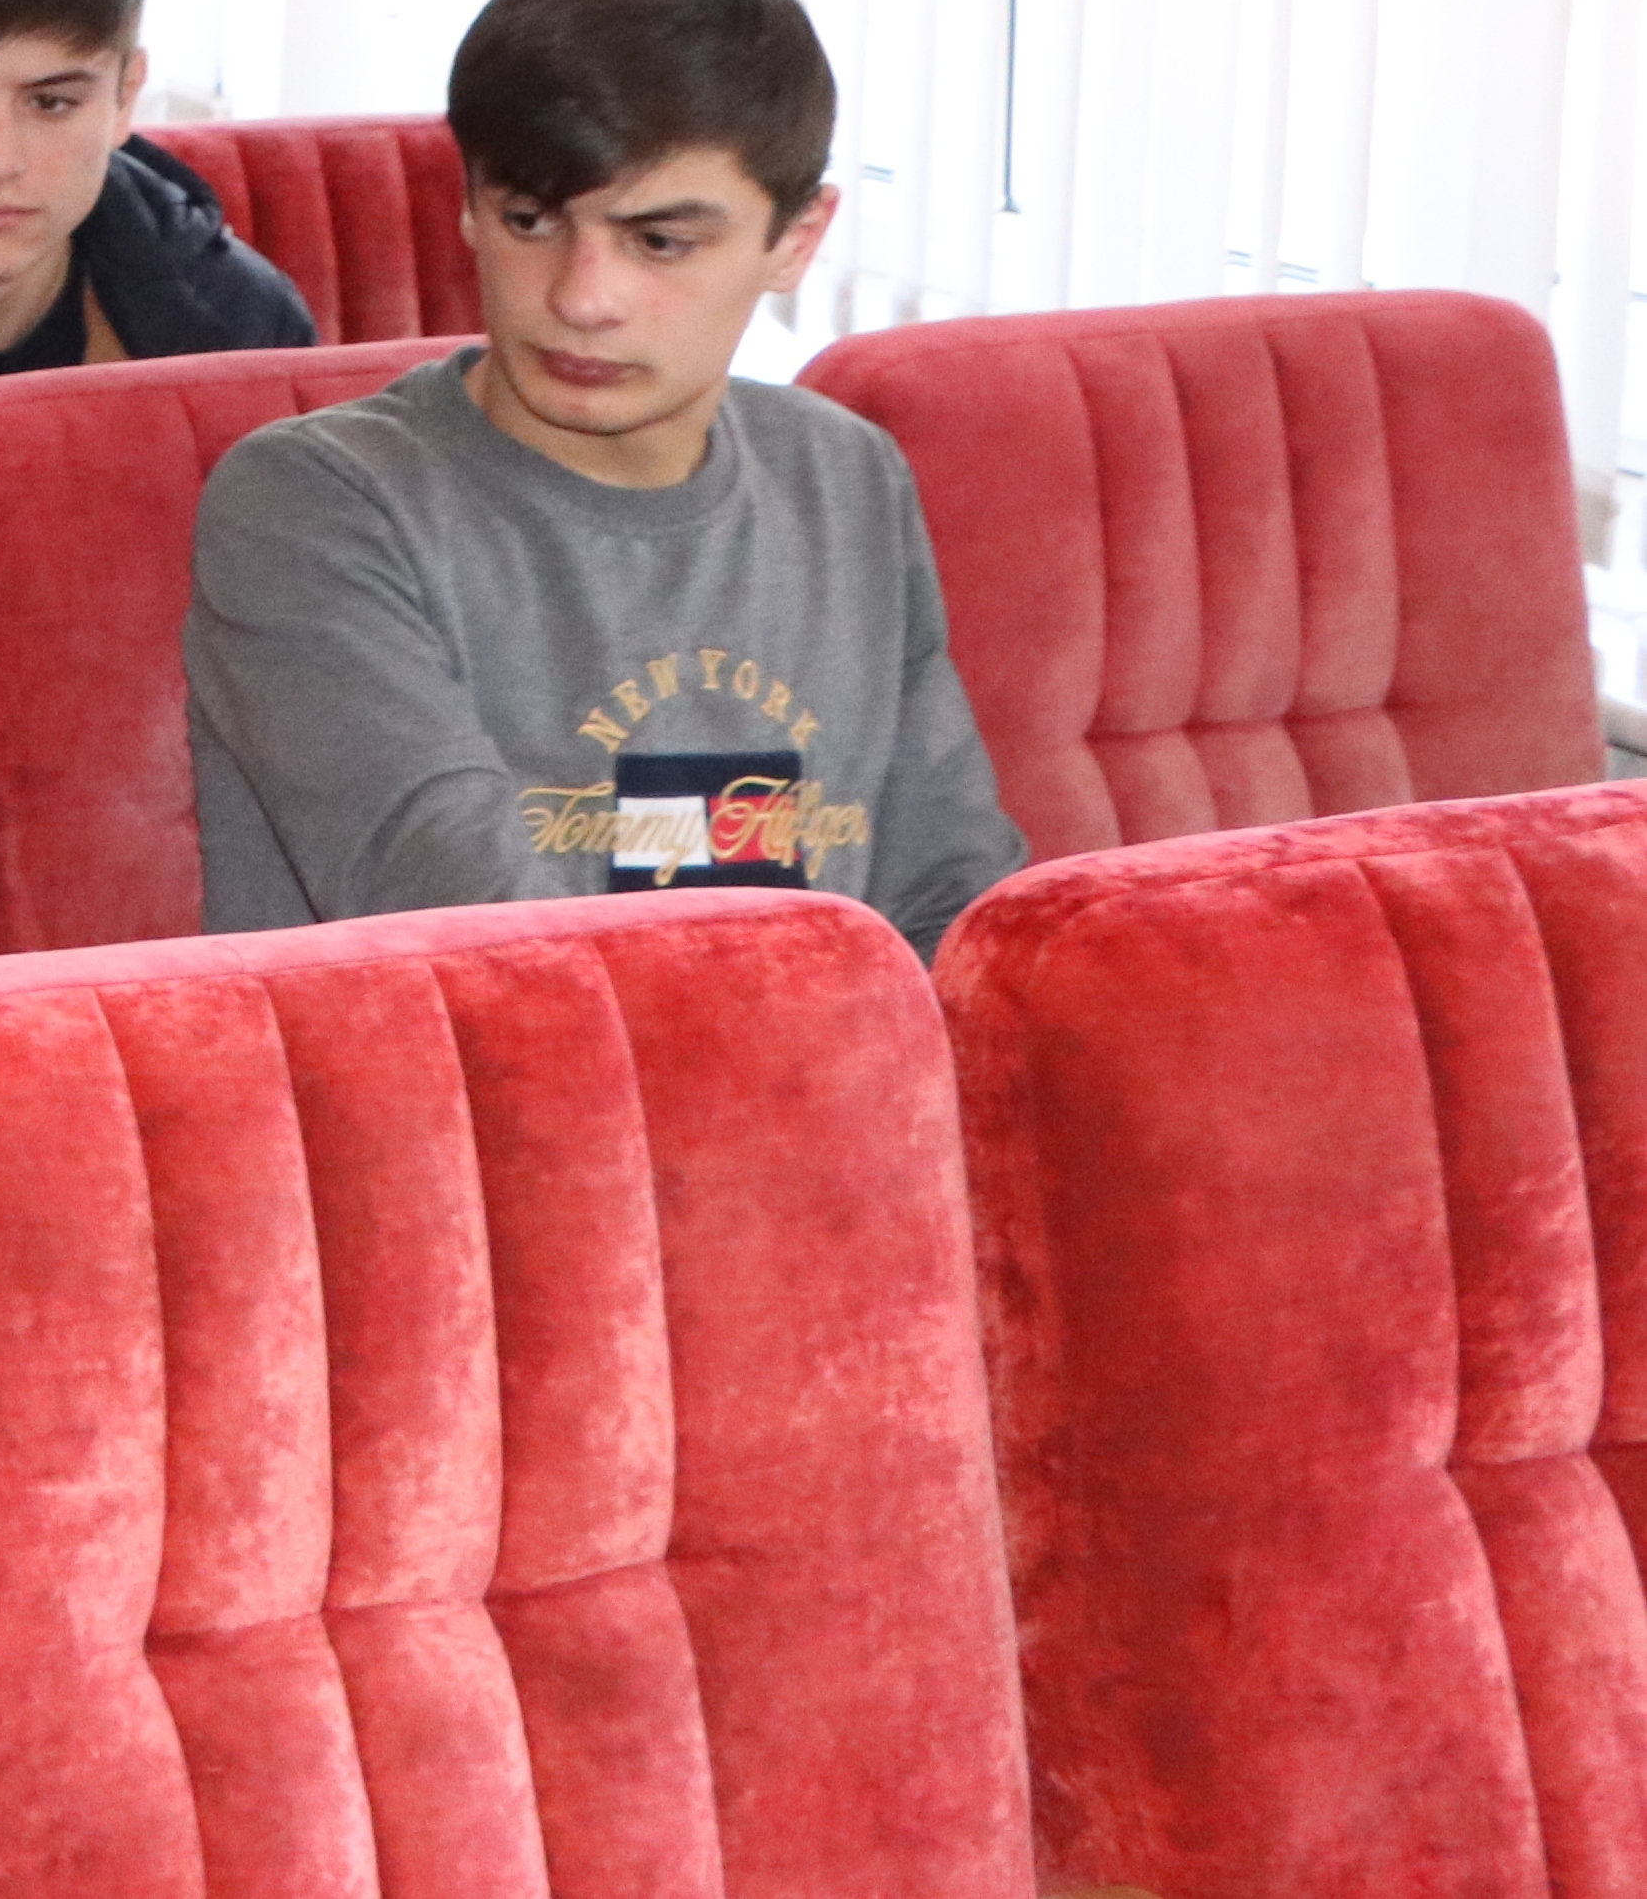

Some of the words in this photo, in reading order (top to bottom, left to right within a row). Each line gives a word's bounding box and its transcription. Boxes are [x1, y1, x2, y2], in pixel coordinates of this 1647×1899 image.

[576, 652, 681, 754] NEW
[698, 648, 823, 748] YORK
[518, 781, 705, 886] Tommy
